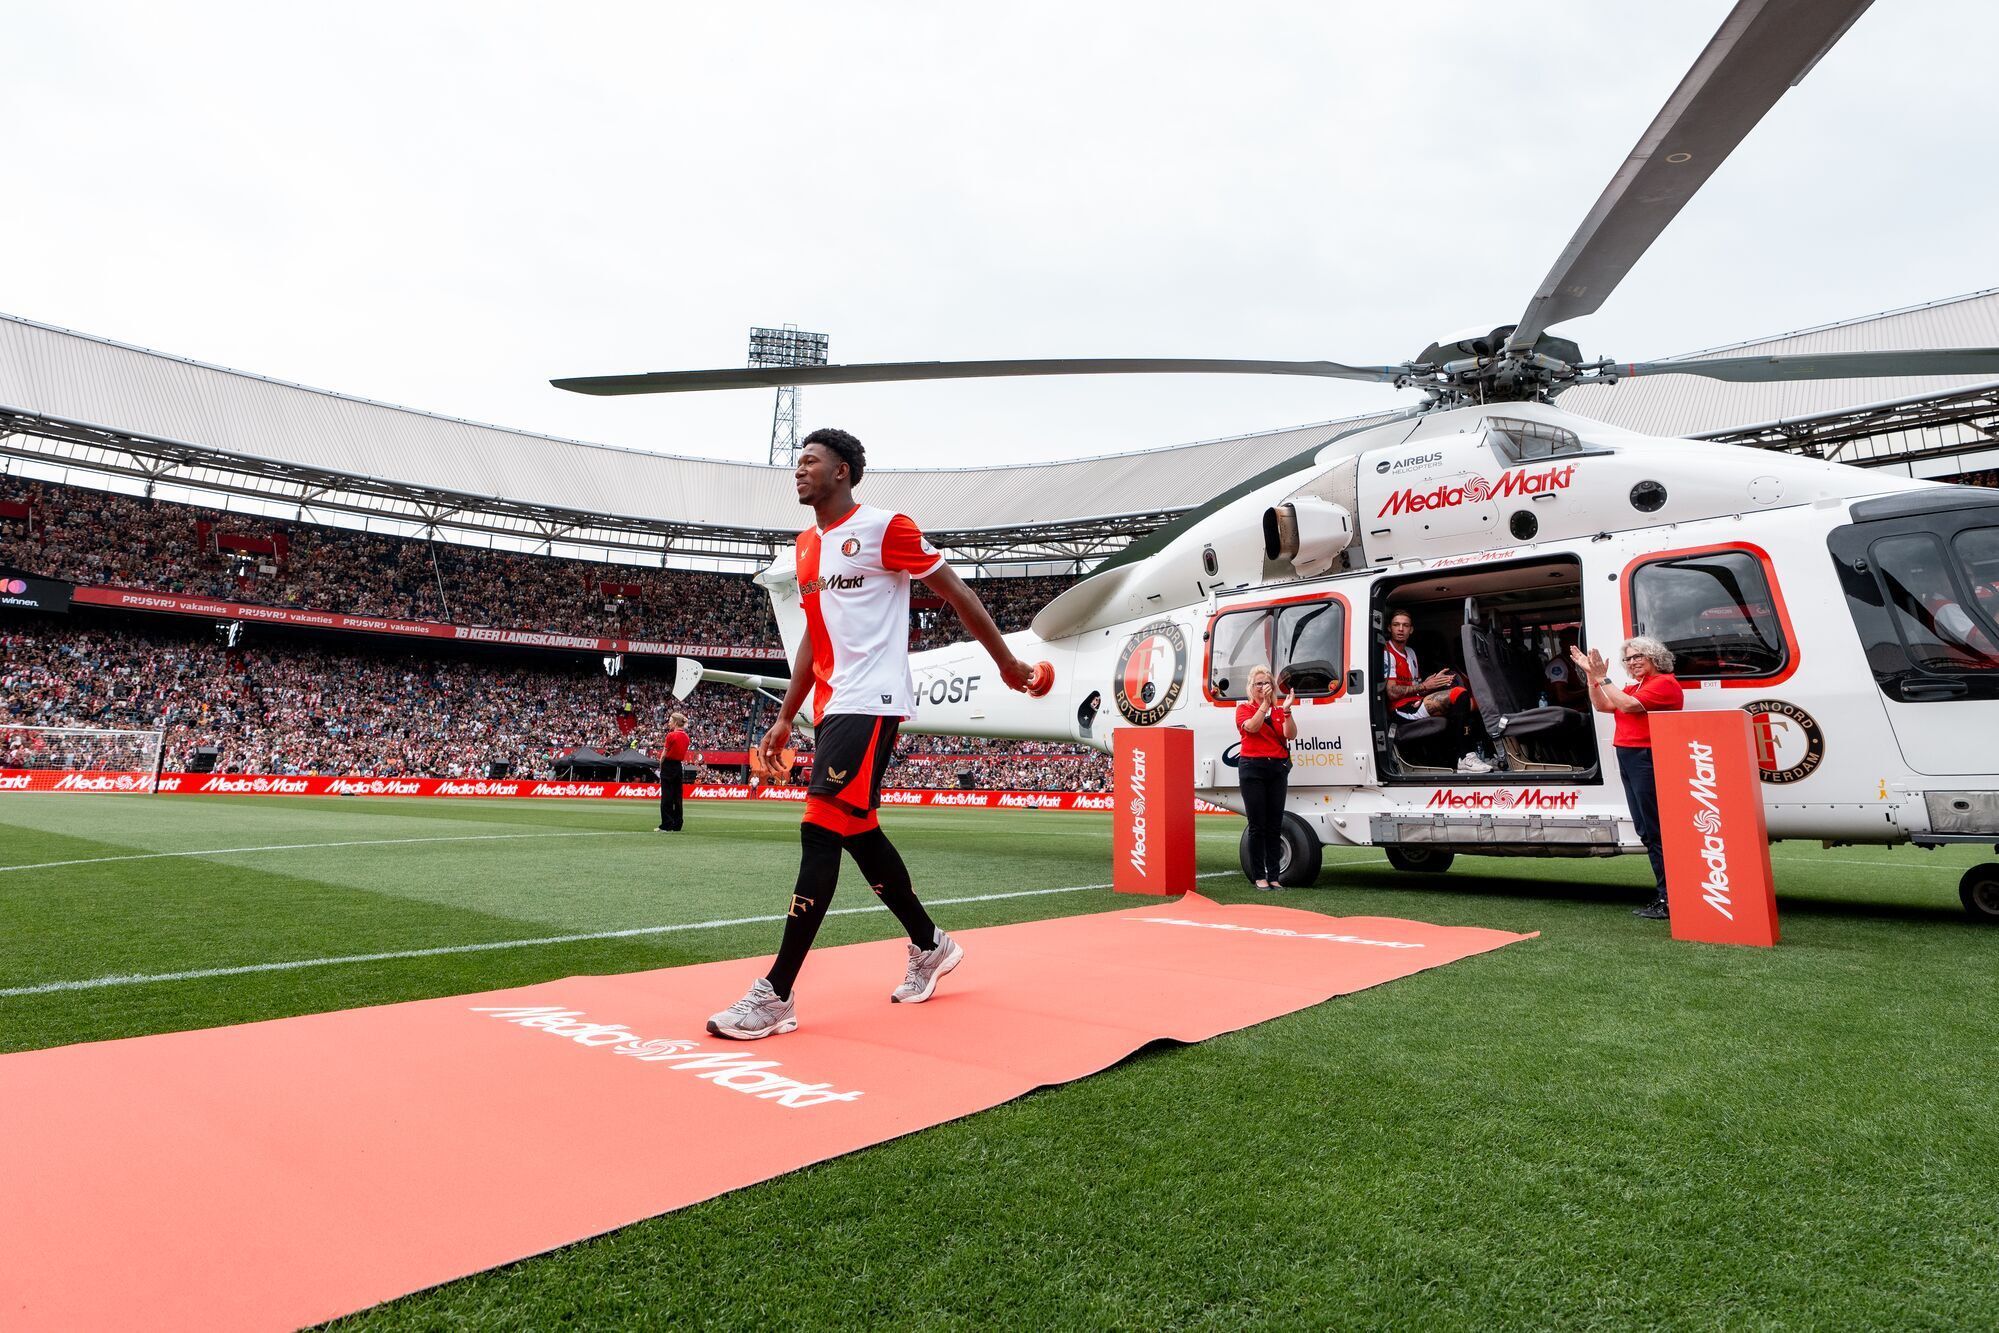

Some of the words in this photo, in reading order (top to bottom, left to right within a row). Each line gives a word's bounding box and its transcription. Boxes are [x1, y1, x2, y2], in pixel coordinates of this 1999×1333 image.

[1392, 461, 1443, 475] HELICOPTERS
[1393, 451, 1443, 469] AIRBUS
[1377, 487, 1465, 518] Media
[1487, 465, 1576, 501] Markt
[1430, 556, 1471, 568] Media
[1479, 550, 1516, 561] Markt
[800, 581, 818, 596] edia
[826, 574, 864, 590] Markt
[180, 601, 227, 614] vakanties
[290, 613, 333, 624] vakanties
[390, 623, 430, 633] vakanties
[455, 627, 468, 638] 16
[468, 628, 501, 641] KEER
[501, 631, 599, 649] LANDSKAMPIOEN
[1121, 622, 1185, 661] FEYENOORD
[628, 641, 681, 655] WINNAAR
[682, 646, 708, 657] UEFA
[708, 647, 729, 657] CUP
[729, 647, 753, 658] 1974
[754, 648, 765, 659] &
[767, 648, 787, 660] 200
[1132, 645, 1165, 700] F
[1116, 682, 1181, 724] ROTTERDAM
[1748, 702, 1814, 729] ENOORD
[1295, 736, 1342, 750] Holland
[1753, 721, 1789, 762] F
[1289, 754, 1344, 767] FSHORE
[1761, 752, 1820, 782] TERDAM
[0, 773, 32, 788] arkt
[54, 774, 115, 790] Media
[1130, 747, 1146, 802] Markt
[1687, 740, 1720, 815] Markt
[200, 777, 251, 792] Media
[266, 778, 308, 793] Markt
[324, 779, 370, 793] Media
[382, 781, 420, 794] Markt
[434, 781, 475, 795] Media
[485, 782, 518, 796] Markt
[530, 784, 567, 796] Media
[574, 784, 605, 797] Markt
[615, 785, 647, 797] Media
[690, 786, 719, 798] Media
[726, 786, 749, 798] Markt
[759, 788, 784, 799] Media
[899, 792, 923, 804] Markt
[930, 792, 957, 805] Media
[963, 793, 989, 806] Markt
[997, 794, 1026, 806] Media
[1036, 795, 1062, 807] Markt
[1072, 795, 1105, 809] Media
[1426, 788, 1495, 810] Media
[1510, 788, 1579, 810] Markt
[1129, 816, 1146, 877] Media
[1700, 834, 1734, 921] Media
[787, 893, 815, 917] F
[469, 1006, 642, 1047] Media
[637, 1051, 866, 1109] Markt
